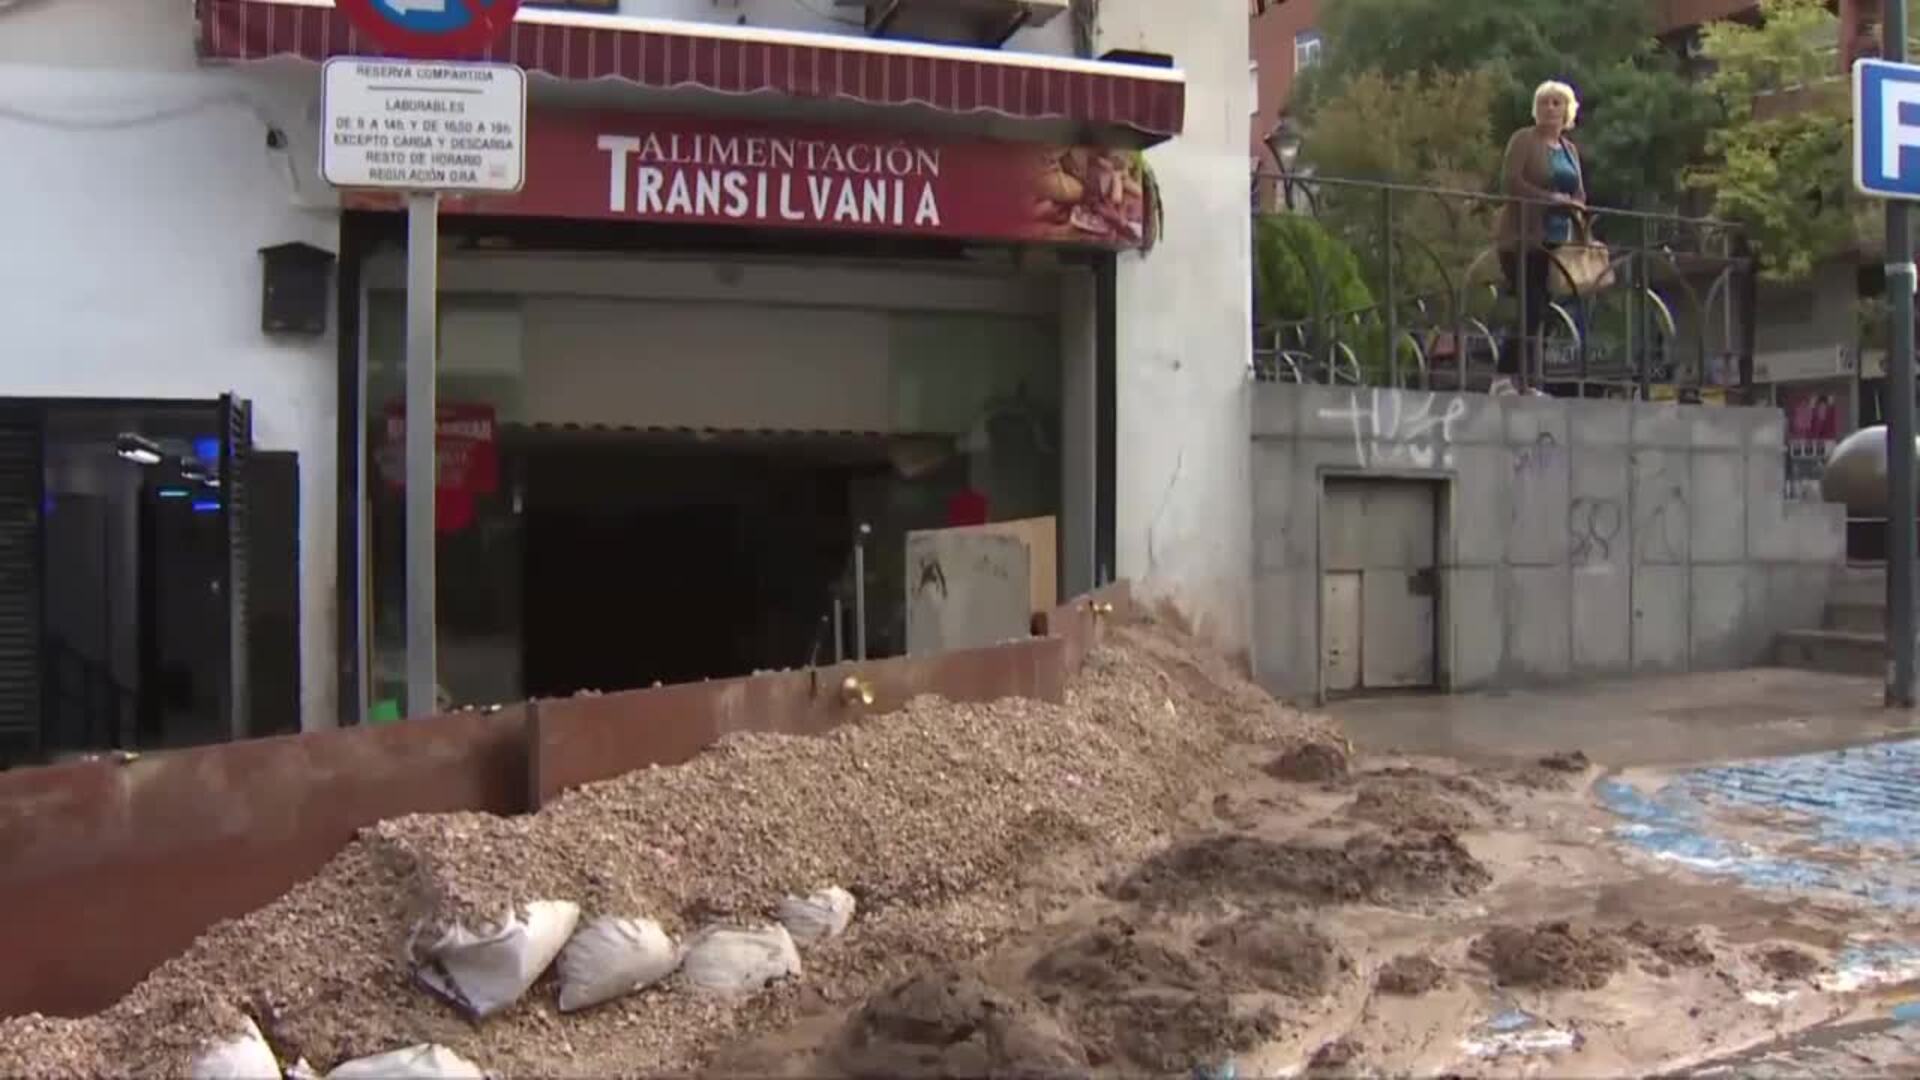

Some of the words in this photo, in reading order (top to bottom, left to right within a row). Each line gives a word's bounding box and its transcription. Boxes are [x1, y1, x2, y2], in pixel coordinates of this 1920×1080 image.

[356, 64, 412, 79] RESERVA
[416, 67, 494, 82] COMPARTIDA
[385, 99, 465, 113] LABORABLES
[335, 116, 350, 129] DE
[370, 118, 379, 130] A
[410, 119, 418, 131] Y
[423, 120, 438, 133] DE
[477, 122, 486, 134] A
[333, 131, 389, 146] EXCEPTO
[393, 134, 433, 148] CARGA
[438, 137, 445, 148] Y
[450, 137, 514, 151] DESCARGA
[365, 150, 405, 164] RESTO
[409, 152, 426, 165] DE
[431, 152, 482, 167] HORARIO
[639, 132, 940, 177] ALIMENTACIÓN
[598, 134, 941, 226] TRANSILVANIA
